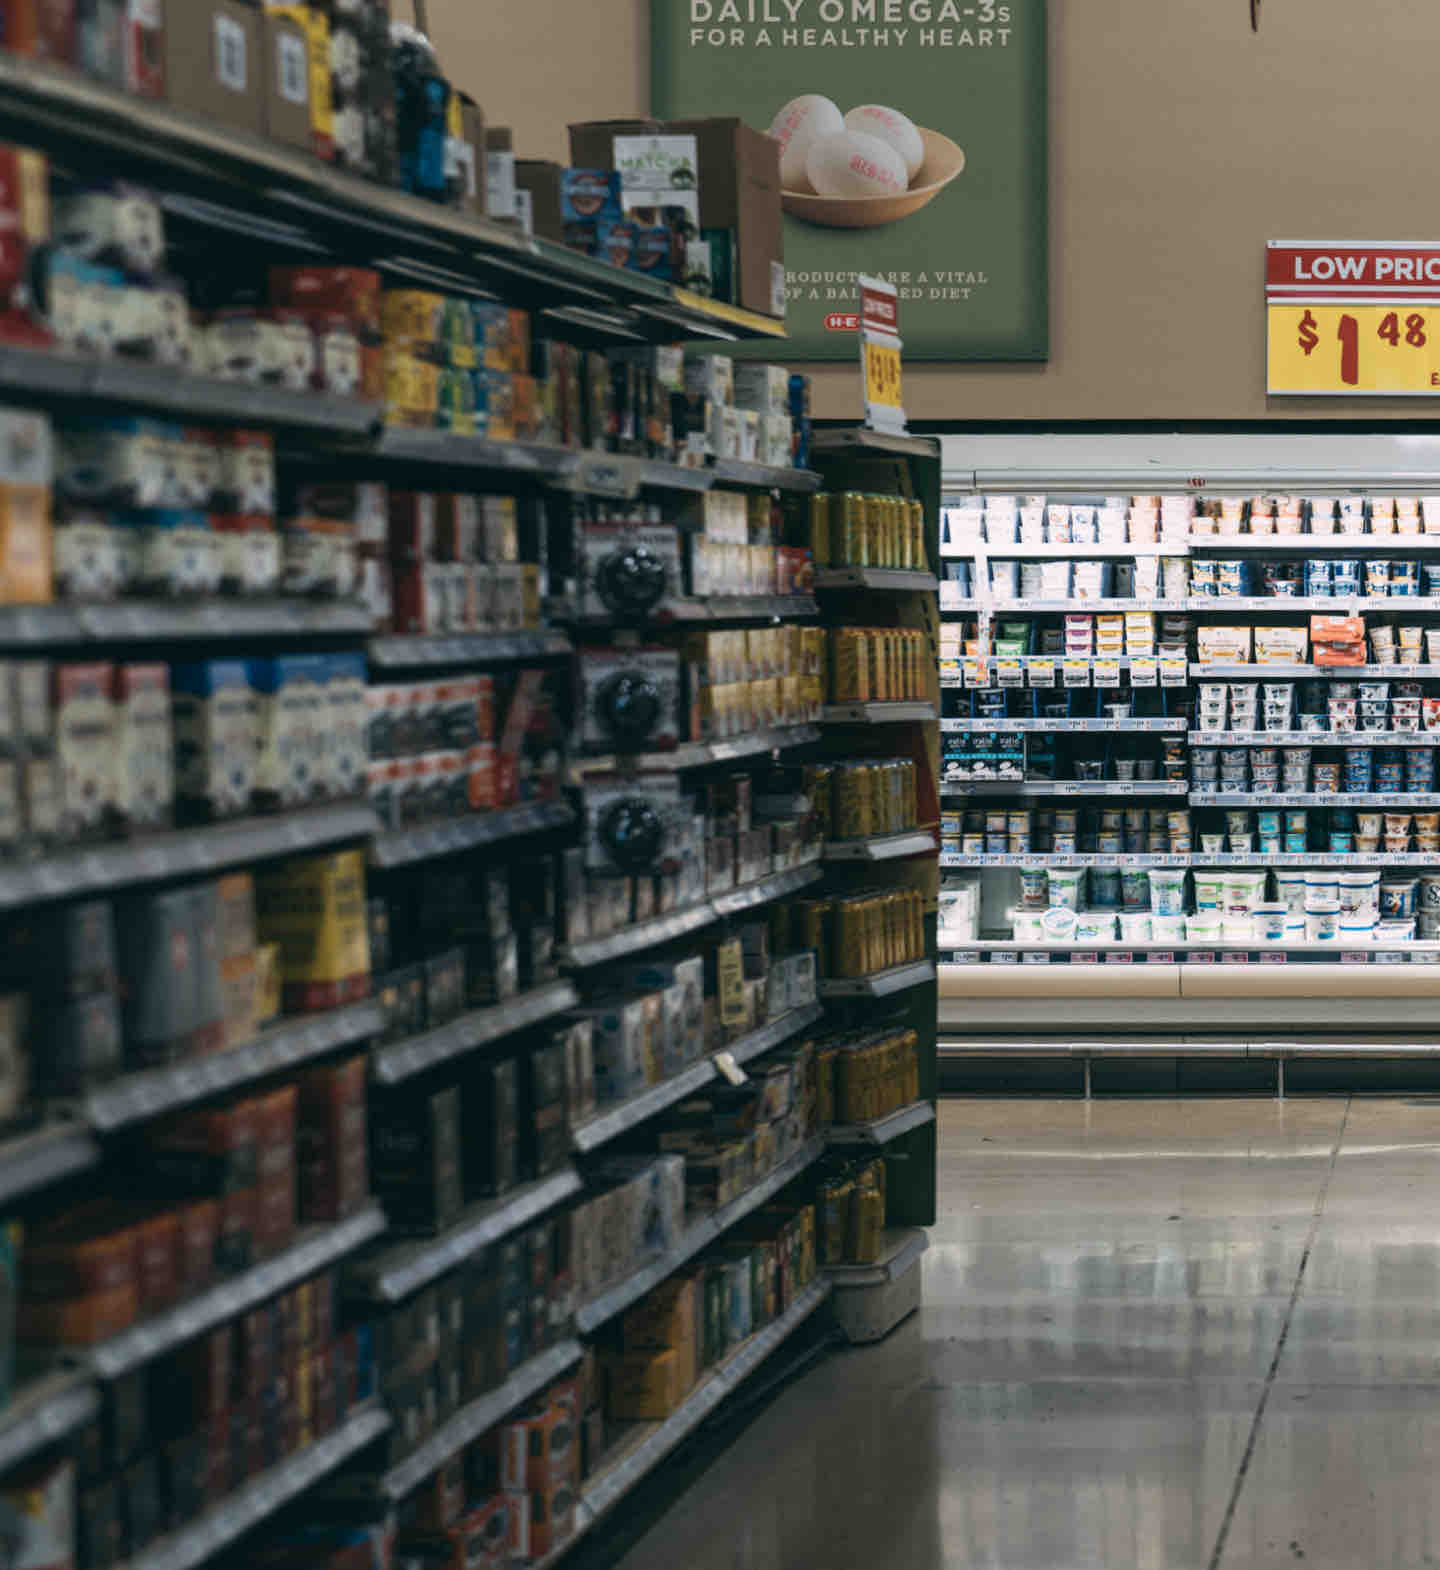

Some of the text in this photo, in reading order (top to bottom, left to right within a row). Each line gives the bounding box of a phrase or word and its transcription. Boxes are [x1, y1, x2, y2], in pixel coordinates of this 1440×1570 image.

[690, 0, 801, 22] DAILY
[690, 28, 1011, 46] FOR A HEALTHY HEART
[1295, 256, 1367, 279] LOW
[784, 271, 988, 283] RODUCT ARE A VITAL
[808, 287, 820, 299] A
[930, 287, 971, 299] DIET
